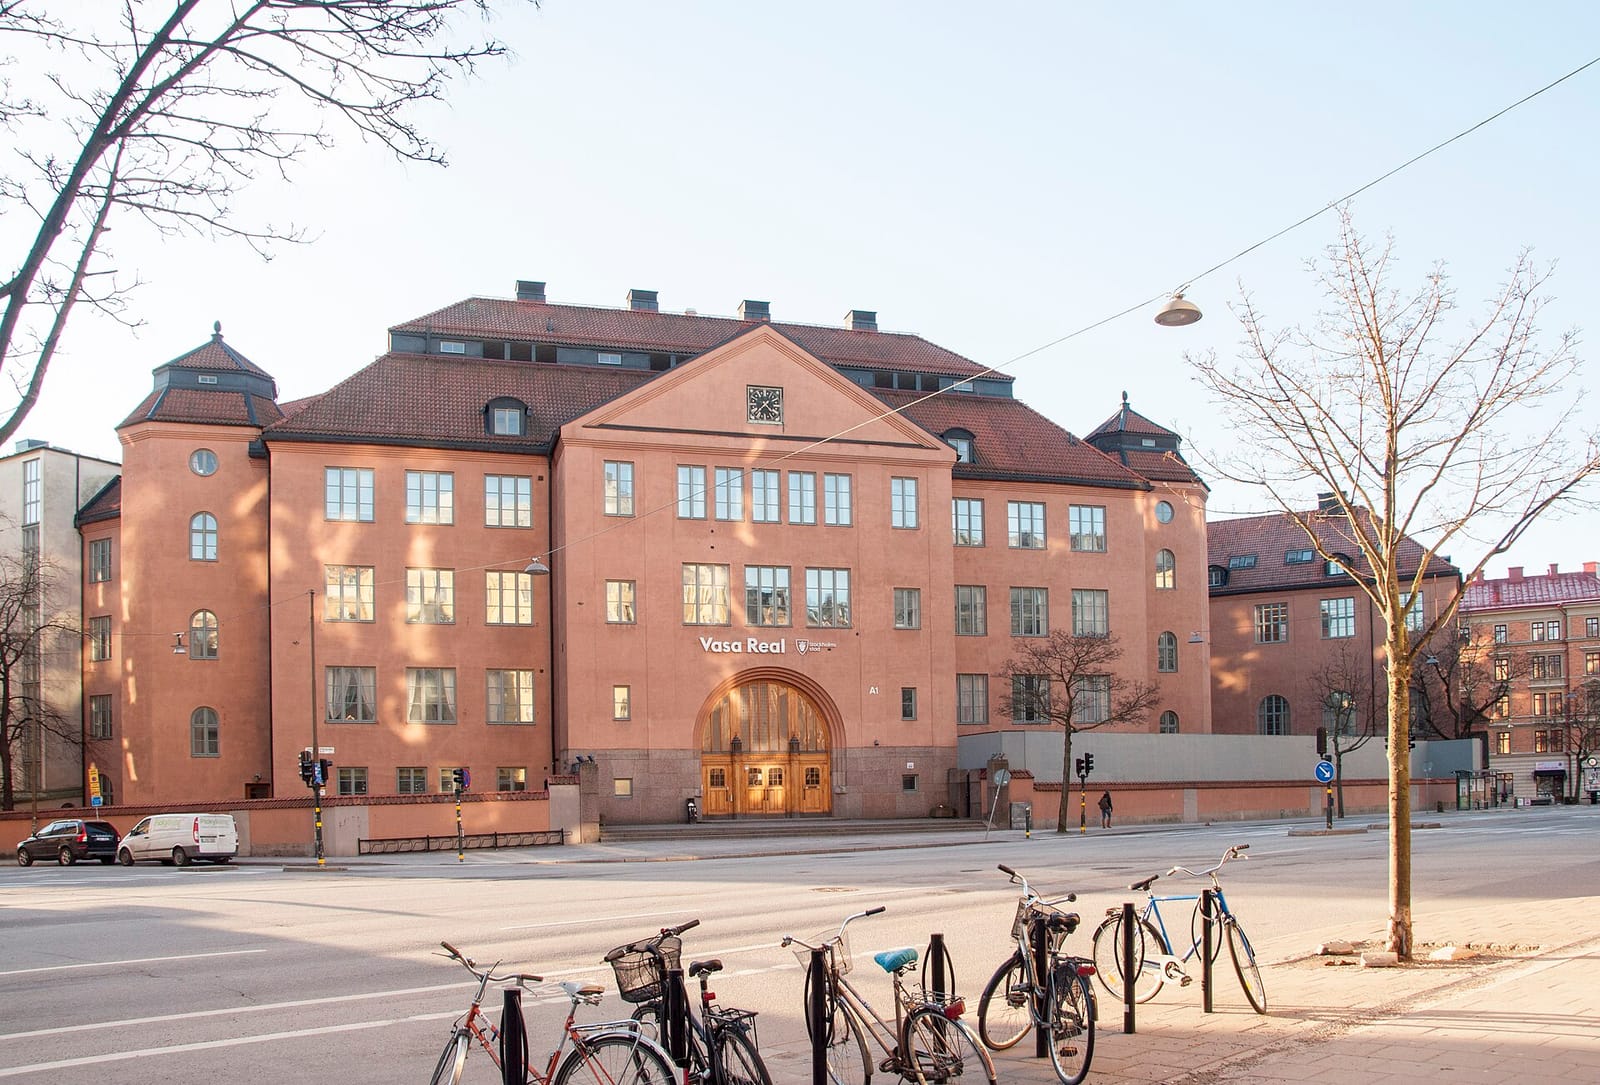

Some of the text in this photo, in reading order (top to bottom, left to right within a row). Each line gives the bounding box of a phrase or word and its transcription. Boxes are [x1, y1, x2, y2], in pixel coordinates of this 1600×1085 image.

[699, 637, 785, 653] Vasa Real
[869, 686, 879, 695] A1
